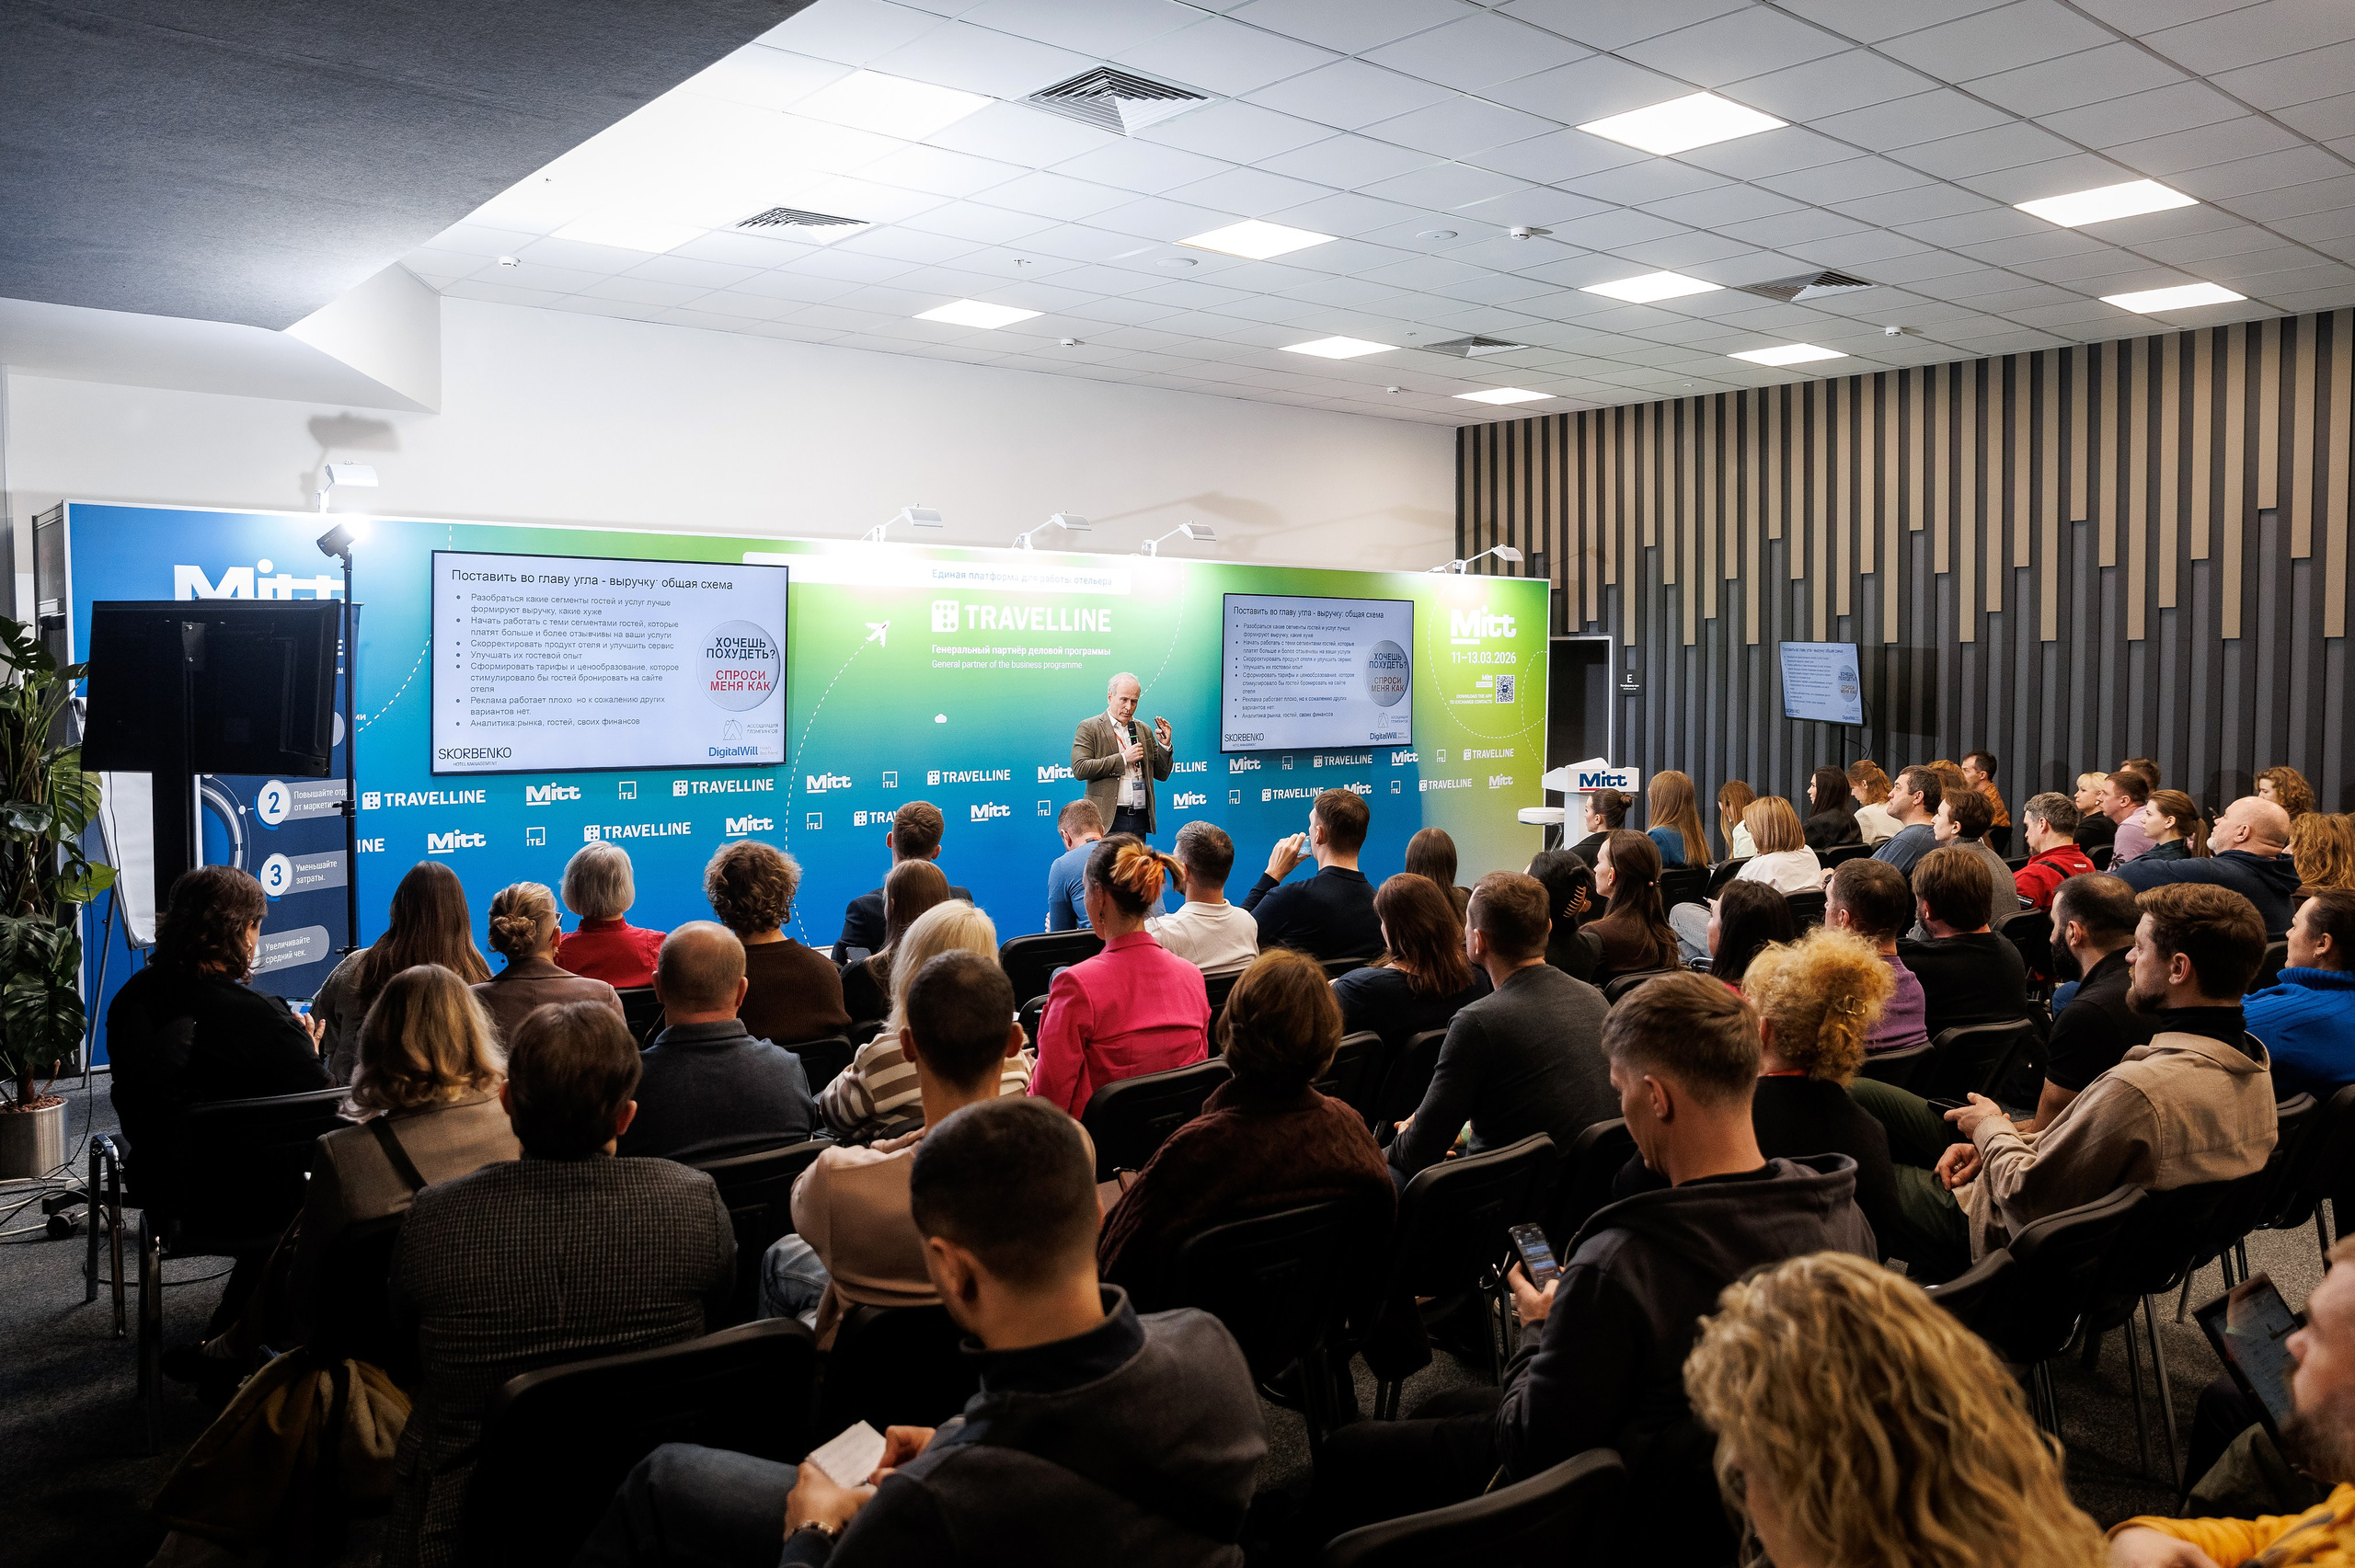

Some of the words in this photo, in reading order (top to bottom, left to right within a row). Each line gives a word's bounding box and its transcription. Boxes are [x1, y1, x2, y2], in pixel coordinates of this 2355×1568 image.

[452, 569, 517, 583] Поставить
[521, 574, 534, 583] во
[538, 575, 570, 587] главу
[573, 576, 599, 587] угла
[661, 578, 698, 589] общая
[700, 579, 733, 589] схема
[932, 569, 966, 579] Единая
[1074, 577, 1112, 587] отельера
[470, 593, 524, 603] Разобраться
[525, 595, 549, 603] какие
[591, 597, 616, 605] гостей
[624, 599, 645, 607] услуг
[646, 600, 672, 608] лучше
[470, 605, 520, 614] формируют
[522, 607, 557, 616] выручку,
[1234, 606, 1269, 615] Поставить
[1279, 609, 1296, 617] главу
[1298, 610, 1312, 618] угла
[1345, 610, 1365, 618] общая
[470, 616, 501, 624] Начать
[503, 617, 541, 626] работать
[619, 620, 646, 629] гостей,
[964, 604, 1112, 633] TRAVELLINE
[1450, 604, 1517, 638] Mitt
[501, 628, 534, 636] больше
[543, 628, 568, 637] более
[569, 630, 612, 638] отзывчивы
[647, 632, 672, 640] услуги
[470, 639, 543, 649] Скорректировать
[545, 641, 577, 649] продукт
[609, 642, 647, 650] улучшить
[648, 643, 674, 651] сервис
[715, 636, 766, 648] ХОЧЕШЬ
[470, 651, 511, 660] Улучшать
[525, 651, 561, 659] гостевой
[706, 647, 776, 660] ПОХУДЕТЬ?
[931, 645, 990, 656] Генеральный
[992, 646, 1027, 657] партнёр
[1028, 646, 1063, 656] деловой
[1064, 647, 1111, 657] программы
[1373, 652, 1402, 661] ХОЧЕШЬ
[470, 662, 534, 671] Сформировать
[535, 663, 569, 672] тарифы
[577, 663, 648, 672] ценообразование,
[931, 659, 960, 669] General
[961, 661, 988, 670] partner
[989, 660, 997, 669] of
[998, 660, 1010, 669] the
[1011, 660, 1042, 669] business
[1043, 661, 1082, 670] programme
[1369, 660, 1407, 670] ПОХУДЕТЬ?
[470, 674, 535, 683] стимулировало
[536, 673, 549, 681] бы
[551, 673, 577, 681] гостей
[578, 673, 628, 682] бронировать
[716, 670, 766, 681] СПРОСИ
[1373, 676, 1402, 684] СПРОСИ
[1626, 673, 1633, 683] E
[709, 681, 744, 692] МЕНЯ
[747, 681, 772, 692] КАК
[1371, 684, 1390, 692] МЕНЯ
[1391, 684, 1405, 692] КАК
[470, 696, 507, 704] Реклама
[509, 696, 546, 705] работает
[639, 696, 665, 704] других
[470, 708, 514, 717] вариантов
[546, 717, 575, 727] гостей,
[602, 717, 640, 727] финансов
[1224, 732, 1265, 742] SKORBENKO
[1369, 731, 1397, 741] DigitalWill
[438, 747, 512, 760] SKORBENKO
[708, 746, 759, 758] DigitalWill
[1391, 750, 1419, 763] Mitt
[1472, 748, 1515, 759] TRAVELLINE
[1229, 756, 1261, 771] Mitt
[1324, 754, 1373, 766] TRAVELLINE
[941, 769, 1011, 784] TRAVELLINE
[1037, 763, 1074, 780] Mitt
[806, 772, 852, 790] Mitt
[1428, 778, 1473, 790] TRAVELLINE
[1488, 773, 1514, 786] Mitt
[1579, 771, 1628, 787] Mitt
[525, 782, 581, 802] Mitt
[690, 778, 775, 794] TRAVELLINE
[293, 788, 334, 800] Повышайте
[334, 788, 347, 796] отд
[384, 789, 487, 807] TRAVELLINE
[1173, 790, 1207, 807] Mitt
[1272, 786, 1325, 800] TRAVELLINE
[268, 791, 281, 814] 2
[971, 801, 1011, 818] Mitt
[725, 814, 775, 833] Mitt
[603, 821, 692, 840] TRAVELLINE
[427, 829, 487, 850] Mitt
[295, 860, 338, 873] Уменьшайте
[270, 864, 282, 887] 3
[295, 874, 326, 885] затраты.
[265, 935, 311, 952] Увеличивайте
[265, 951, 293, 966] средний
[293, 949, 307, 958] чек.
